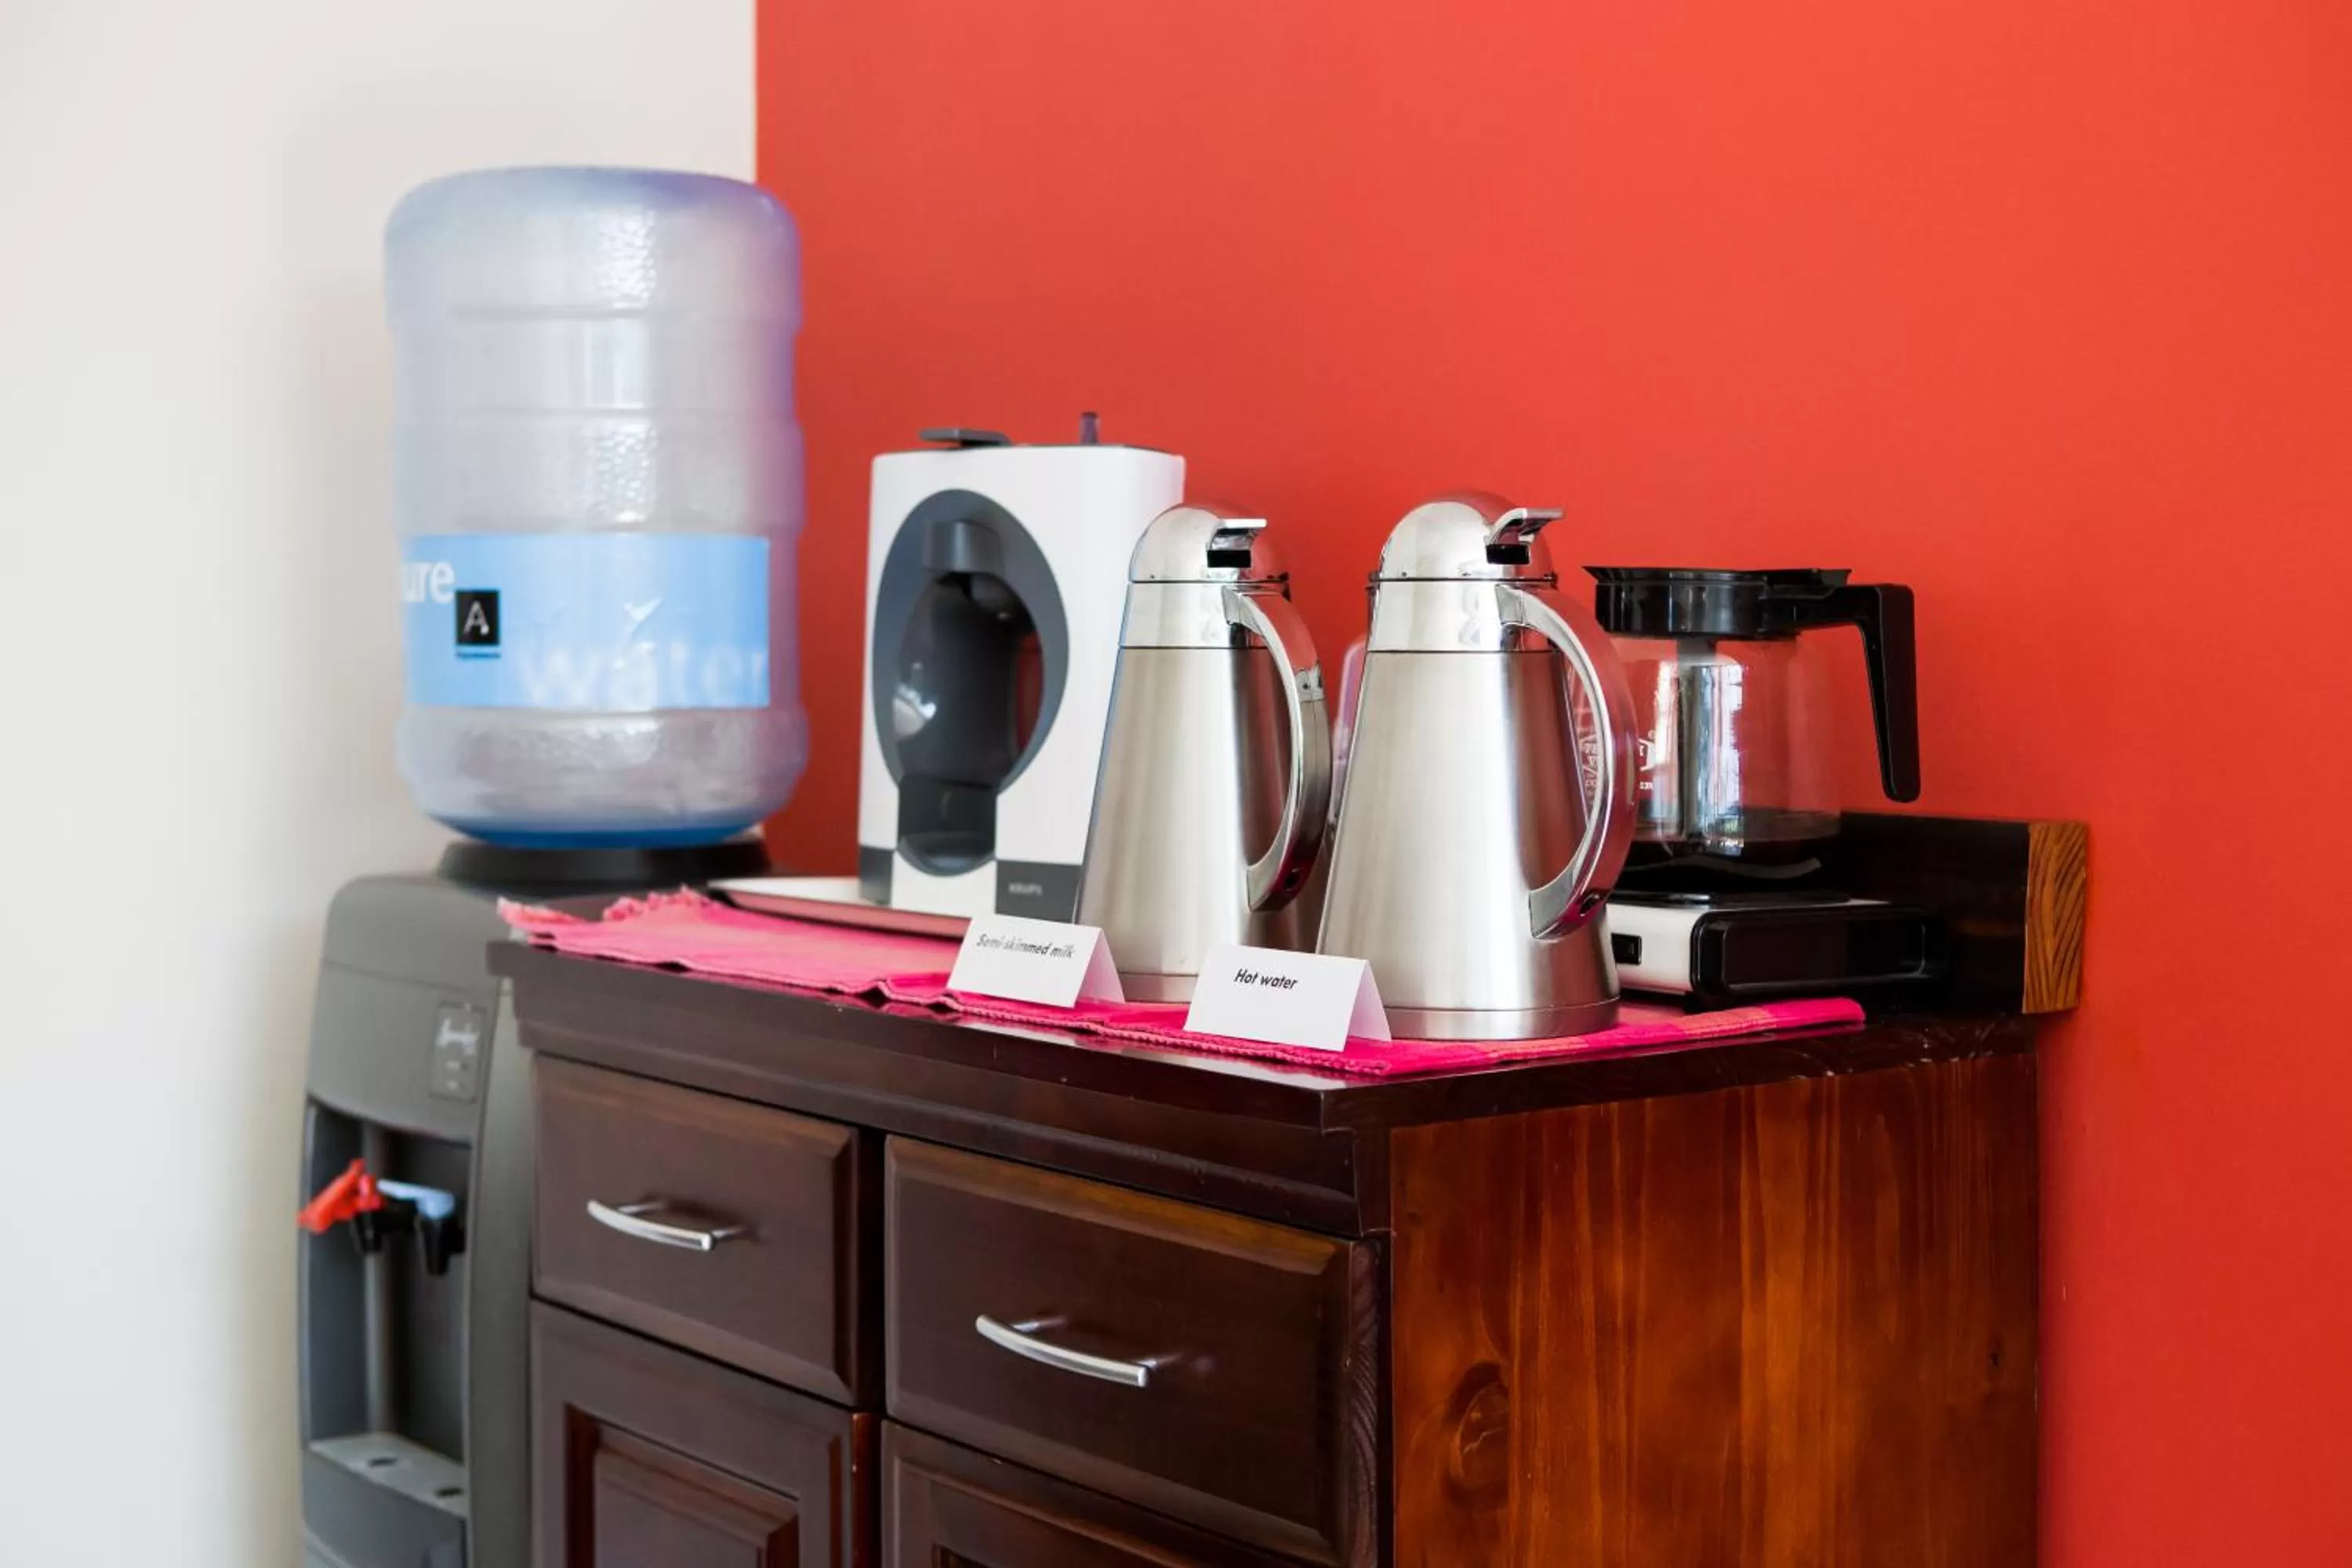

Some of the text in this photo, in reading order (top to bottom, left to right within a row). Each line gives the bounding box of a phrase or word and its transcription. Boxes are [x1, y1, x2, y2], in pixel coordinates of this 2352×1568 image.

[1050, 944, 1074, 958] milk
[1234, 968, 1298, 989] Hot water
